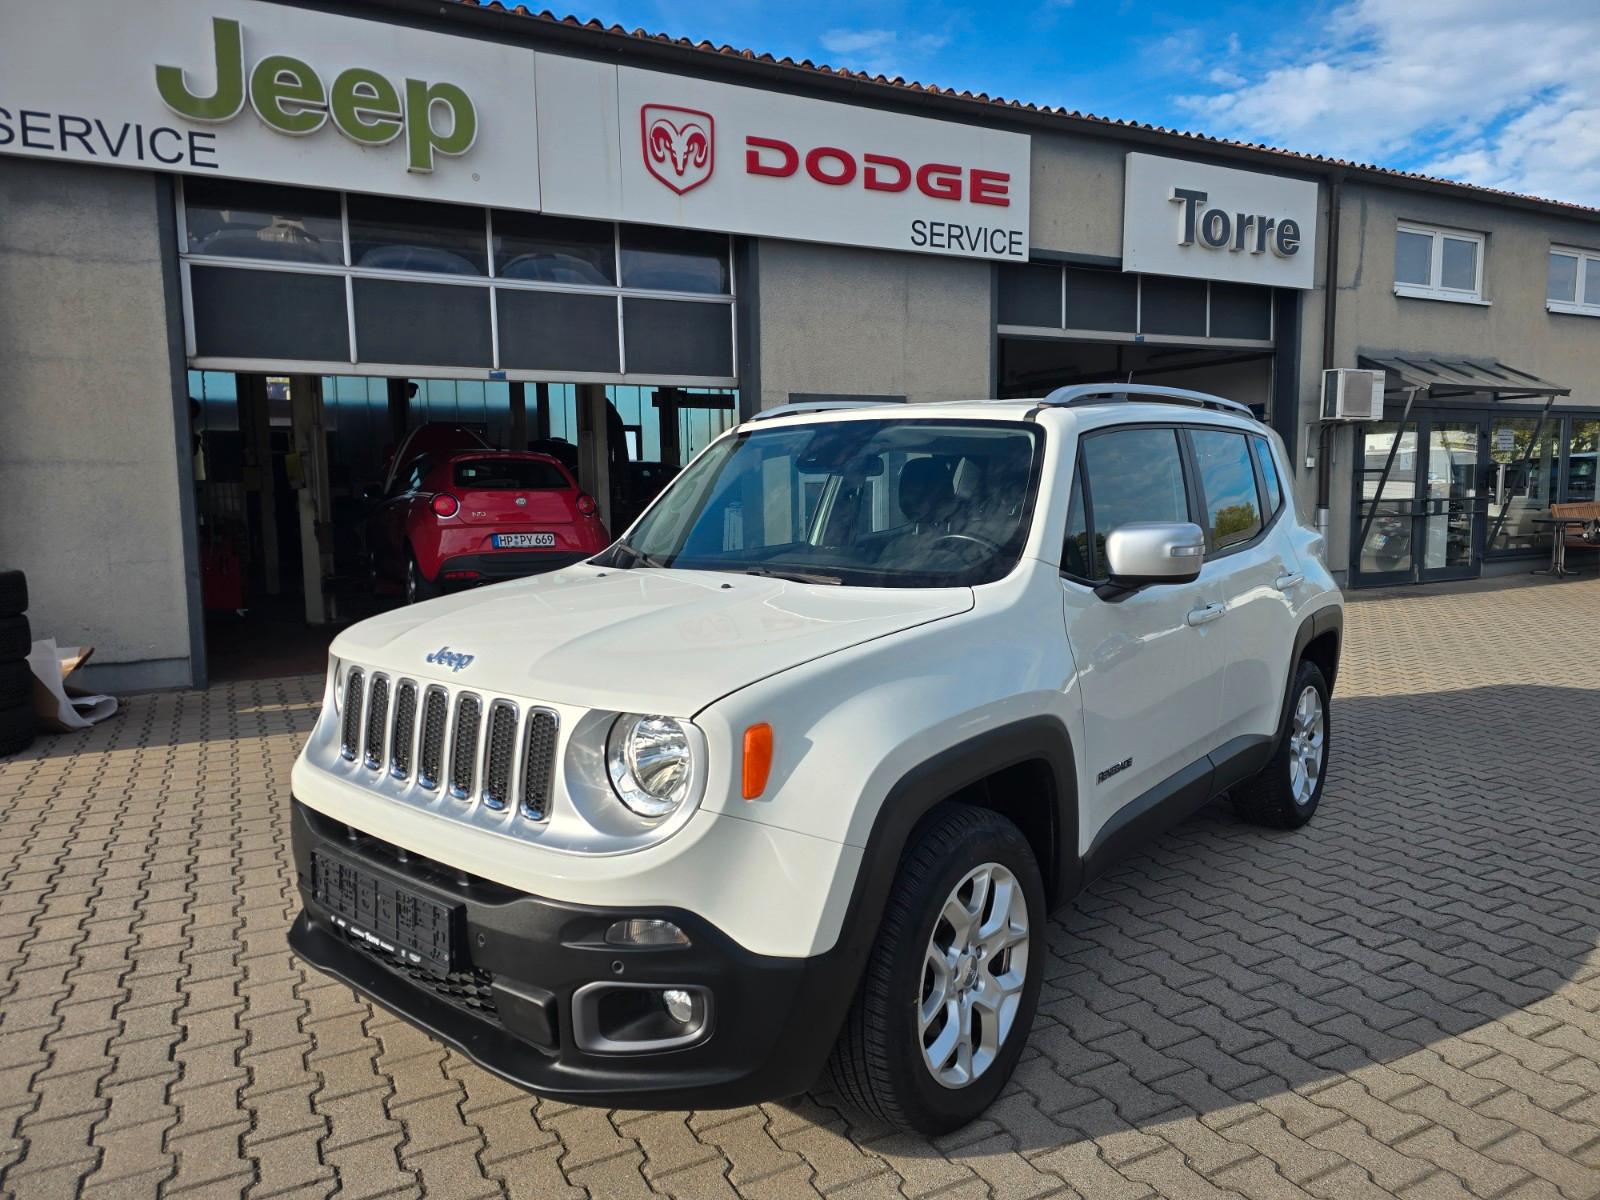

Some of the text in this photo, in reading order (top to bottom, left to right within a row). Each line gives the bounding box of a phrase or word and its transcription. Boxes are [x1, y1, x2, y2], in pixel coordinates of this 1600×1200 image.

[154, 16, 478, 174] Jeep
[745, 135, 1010, 207] DODGE
[910, 219, 1024, 256] SERVICE
[1169, 187, 1301, 257] Torre
[499, 534, 553, 546] HP PY 669
[426, 646, 475, 672] Jeep
